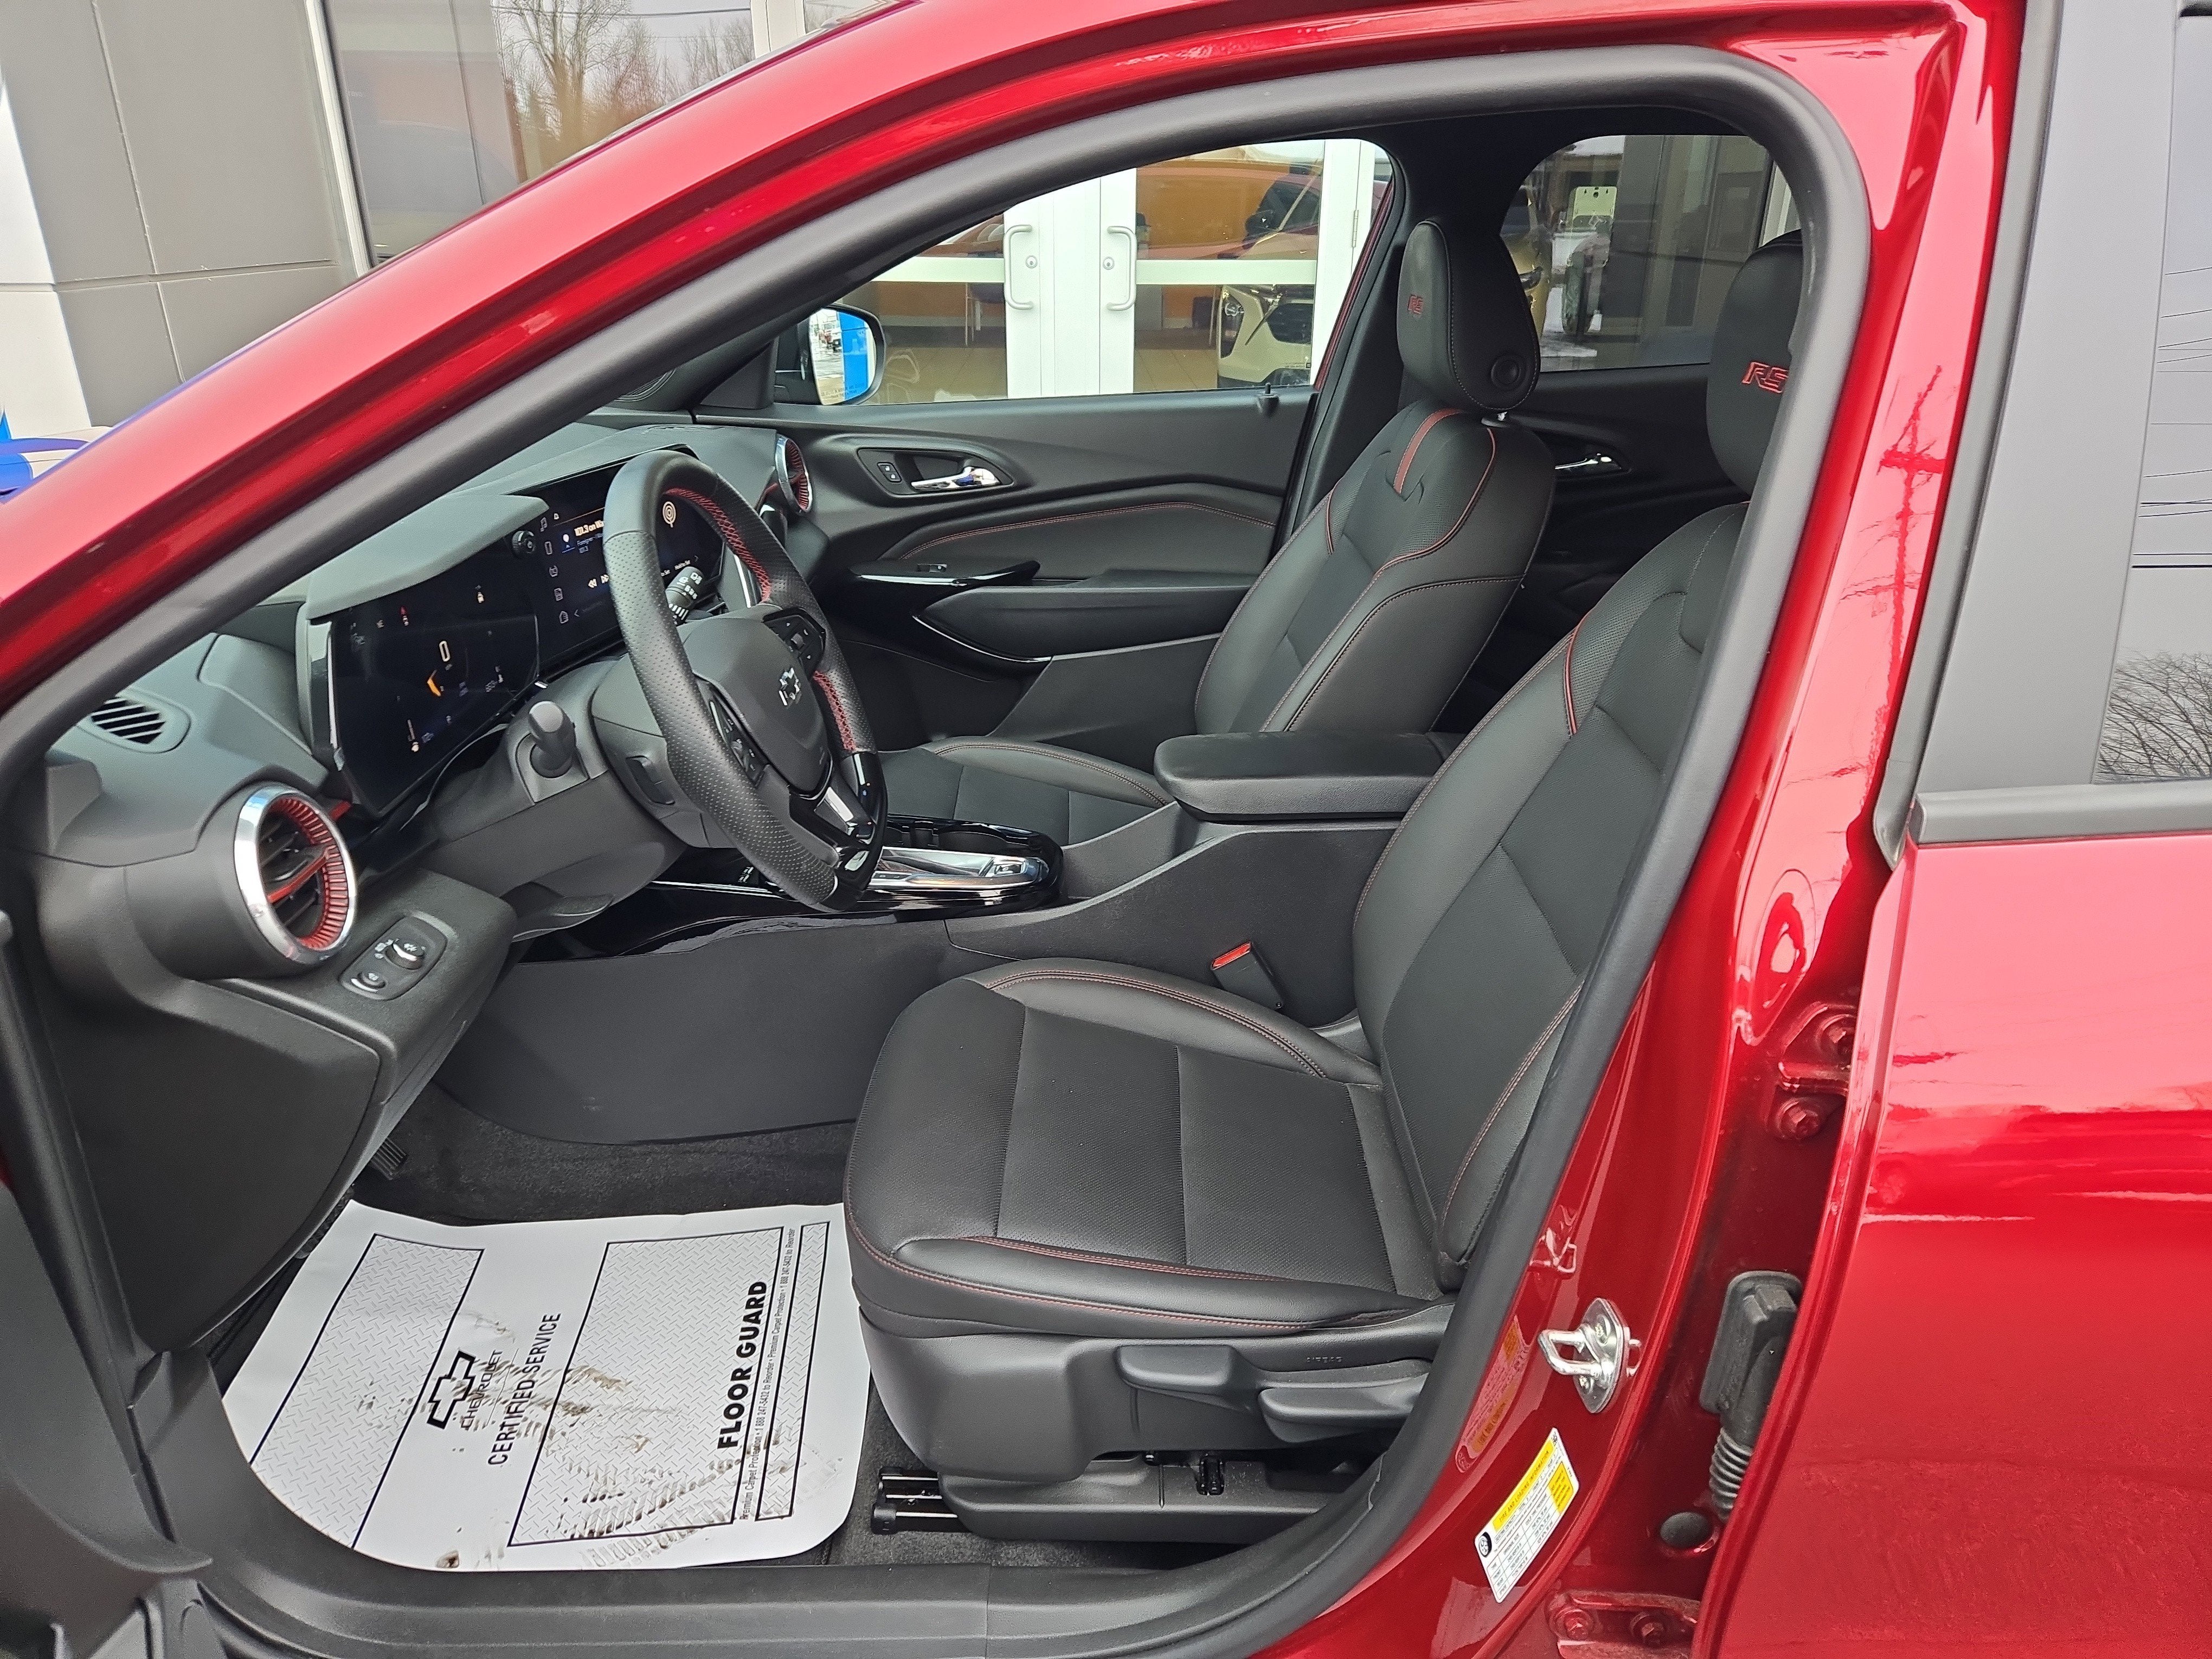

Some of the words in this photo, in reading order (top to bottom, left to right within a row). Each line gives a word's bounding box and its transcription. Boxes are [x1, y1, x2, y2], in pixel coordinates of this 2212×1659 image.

[1741, 362, 1789, 394] RS
[774, 1292, 786, 1317] Protection
[771, 1317, 783, 1334] Carpet
[767, 1335, 779, 1358] Premium
[717, 1365, 754, 1449] FLOOR
[736, 1281, 767, 1358] GUARD
[763, 1362, 774, 1383] Reorder
[461, 1349, 503, 1430] CHEVROLET
[488, 1379, 536, 1465] CERTIFIED
[522, 1313, 561, 1374] SERVICE
[757, 1391, 770, 1415] 247-5432
[755, 1417, 765, 1426] 888
[748, 1436, 762, 1468] Protection
[745, 1470, 758, 1490] Carpet
[740, 1492, 753, 1520] Premium
